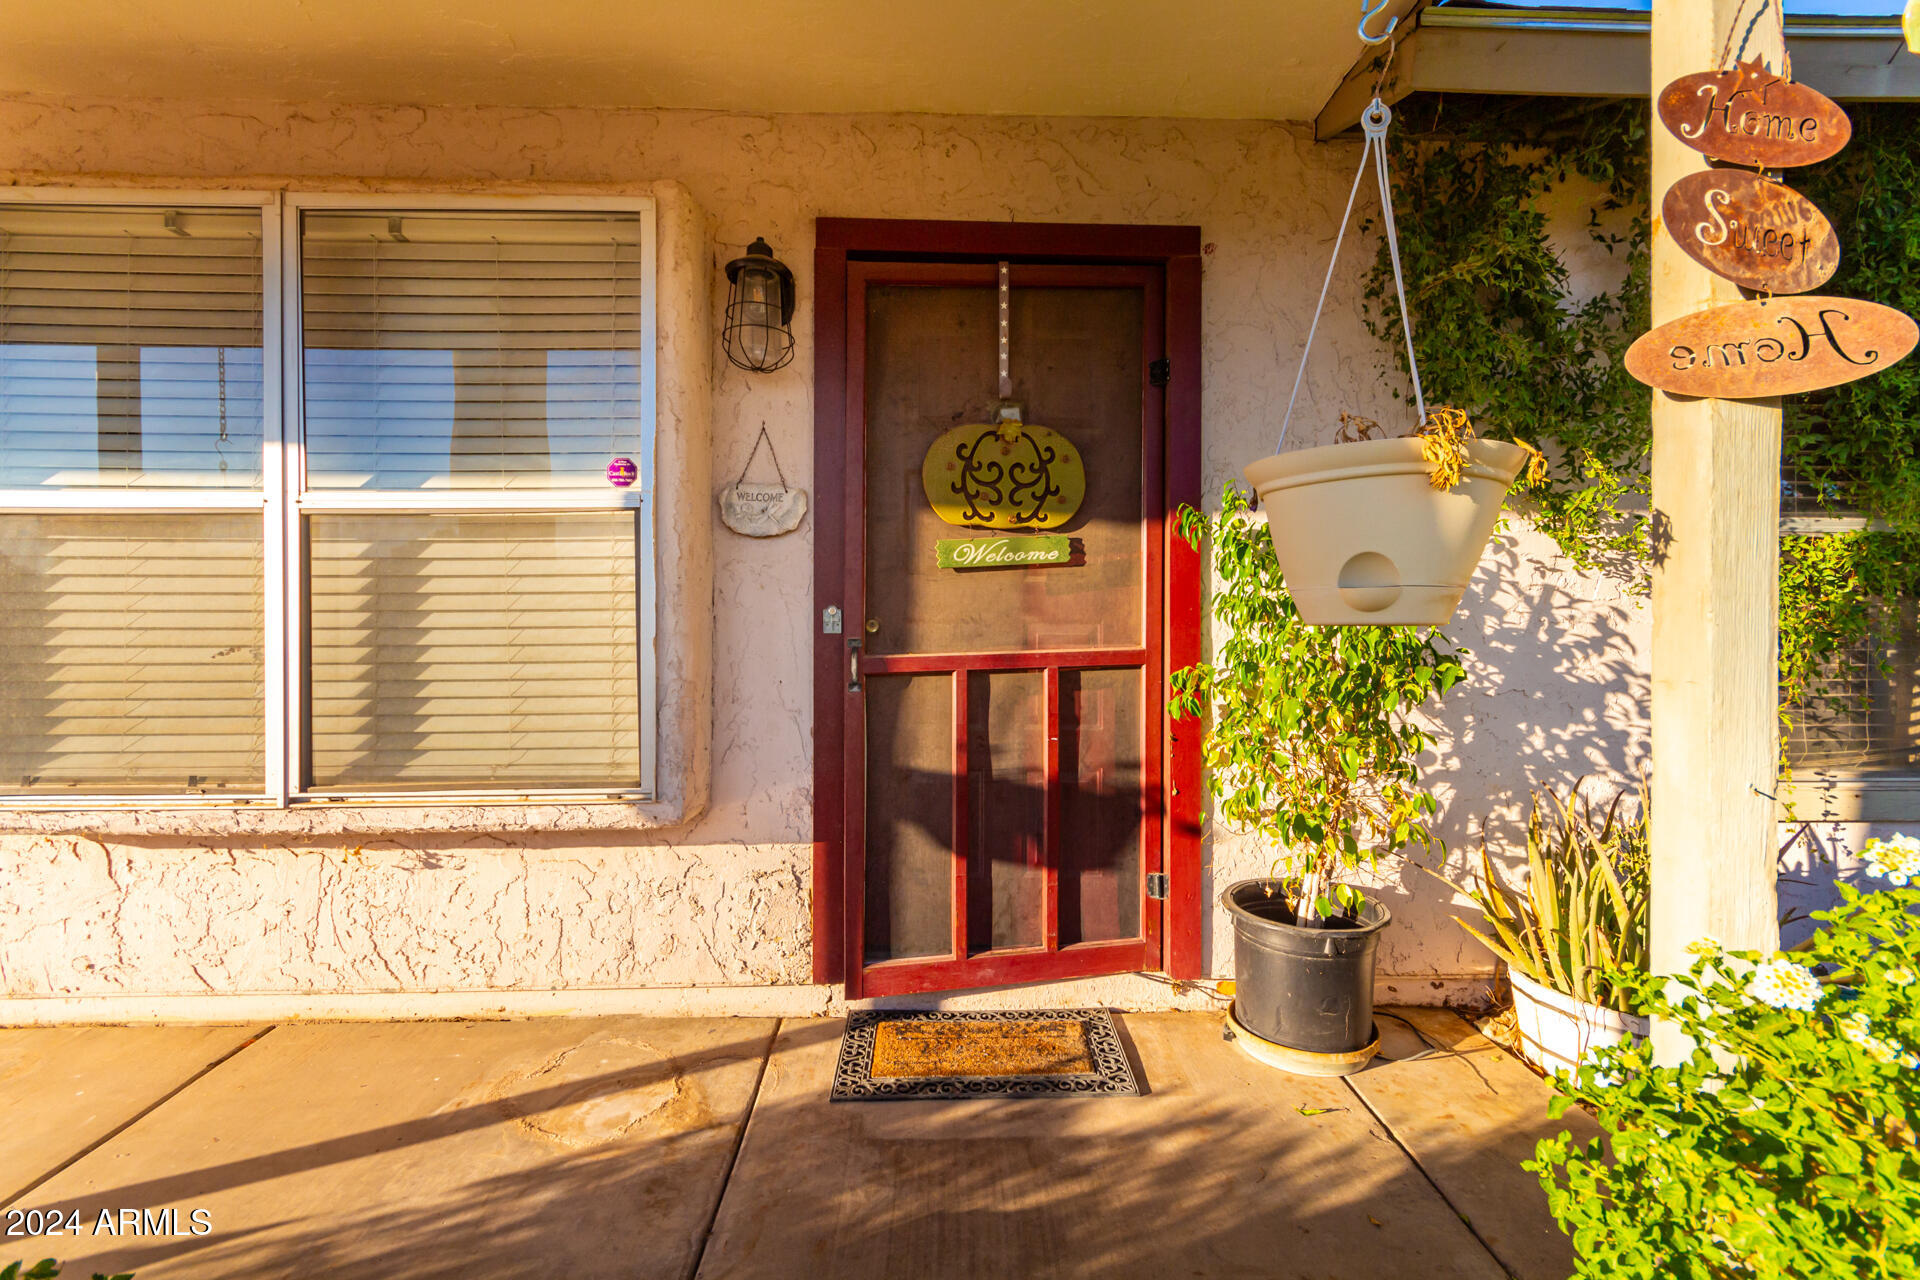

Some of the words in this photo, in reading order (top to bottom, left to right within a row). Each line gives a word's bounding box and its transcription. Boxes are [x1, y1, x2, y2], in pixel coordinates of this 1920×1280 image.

[1680, 85, 1818, 142] Home
[1695, 188, 1811, 264] Sweet
[736, 492, 784, 502] WELCOME
[953, 539, 1060, 565] Welcome
